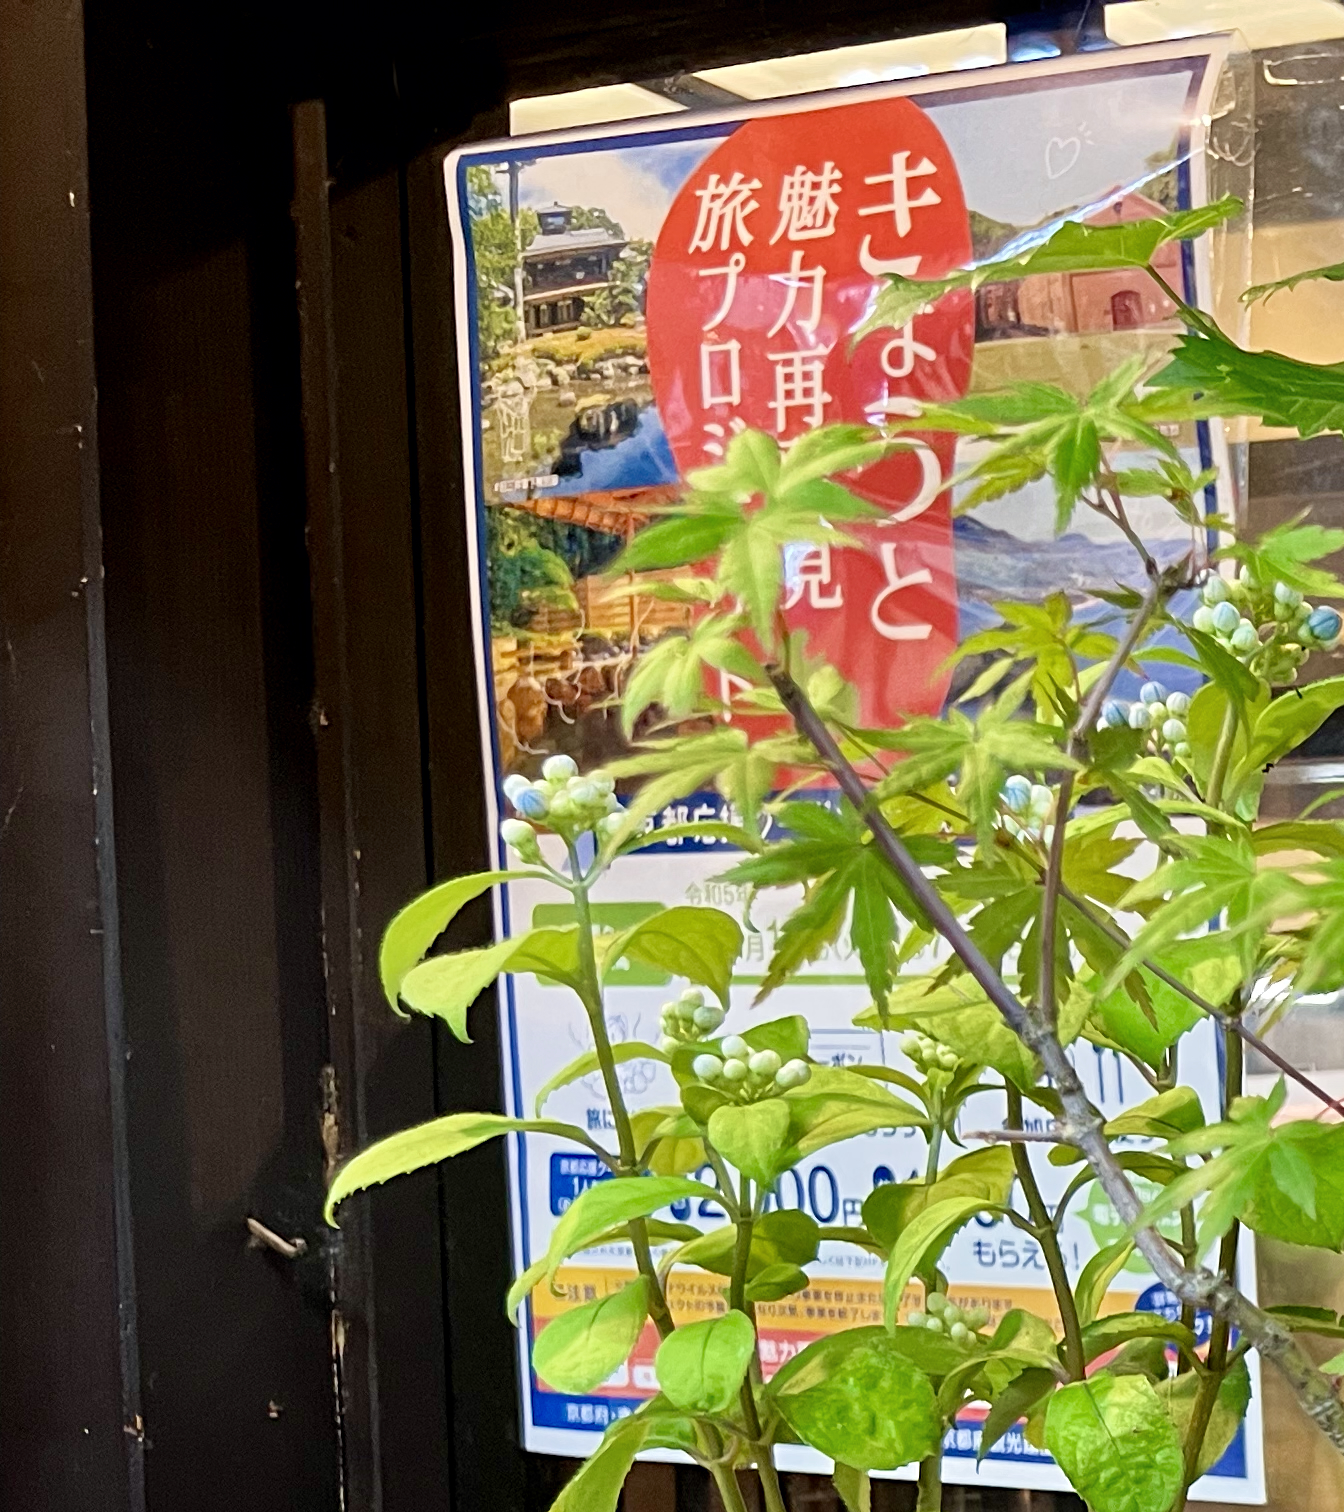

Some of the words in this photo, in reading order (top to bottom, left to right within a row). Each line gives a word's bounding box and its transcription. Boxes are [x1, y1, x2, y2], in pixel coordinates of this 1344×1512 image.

[768, 161, 843, 611] 魅力再見
[973, 1238, 1080, 1272] もらえ!
